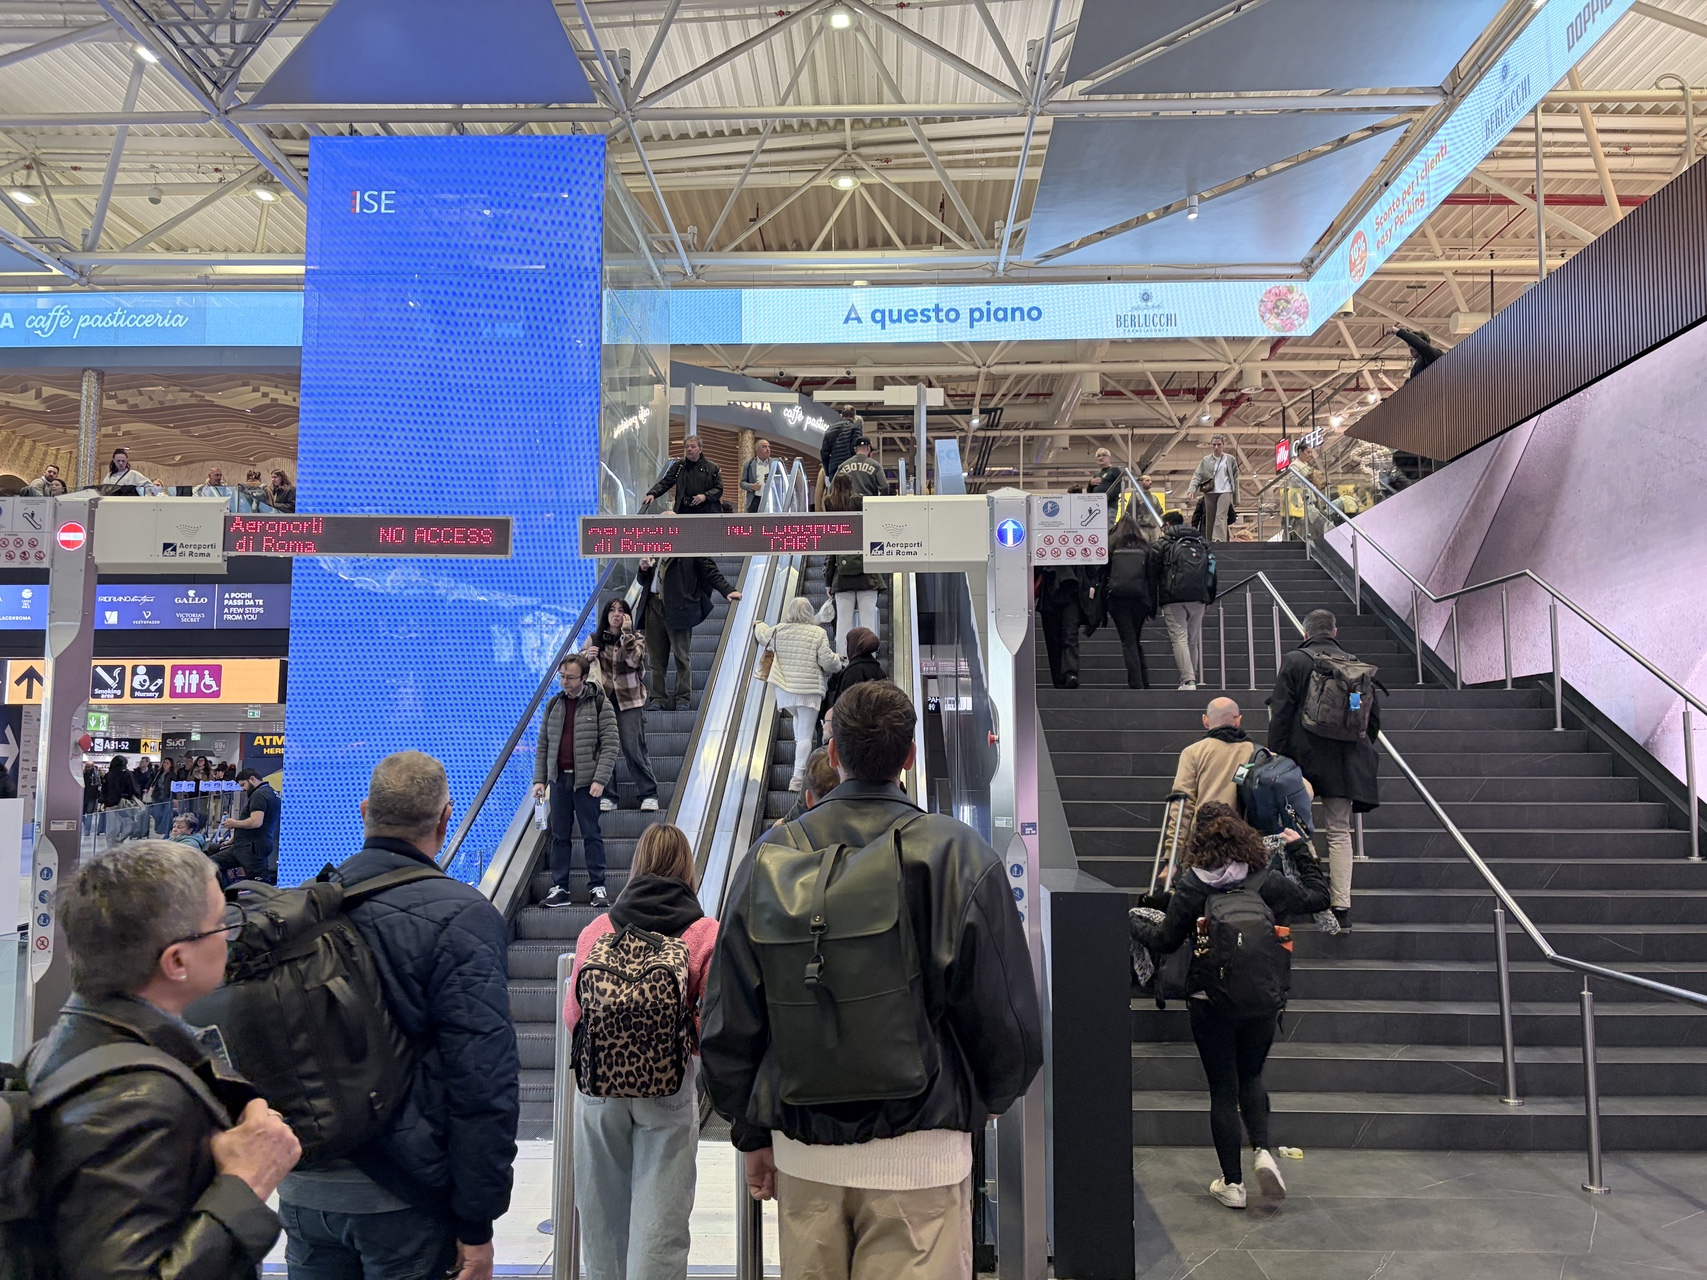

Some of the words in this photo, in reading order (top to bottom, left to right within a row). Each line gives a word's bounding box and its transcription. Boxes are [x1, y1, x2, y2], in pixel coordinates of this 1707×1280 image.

[1485, 74, 1530, 140] BERLUCCHI
[1375, 197, 1400, 232] Sconto
[1402, 180, 1415, 207] per
[1420, 138, 1448, 181] clienti
[355, 190, 396, 214] ISE
[1376, 225, 1393, 250] easy
[1394, 190, 1425, 231] Parking
[25, 305, 73, 338] caffè
[73, 307, 189, 339] pasticceria
[843, 302, 863, 325] A
[871, 303, 961, 330] questo
[969, 300, 1043, 329] piano
[1116, 313, 1177, 329] BERLUCCHI
[783, 405, 804, 425] caffè
[1292, 425, 1324, 456] CFFÈ
[230, 516, 324, 536] Aeroporti
[379, 527, 406, 544] NO
[414, 527, 494, 544] ACCESS
[770, 535, 823, 550] CART
[179, 542, 216, 550] Aeroporti
[236, 537, 253, 552] di
[262, 537, 317, 553] Roma
[594, 539, 611, 552] di
[620, 539, 673, 552] Roma
[94, 688, 121, 696] Smoking
[104, 740, 129, 749] A31-52
[254, 735, 285, 746] ATM
